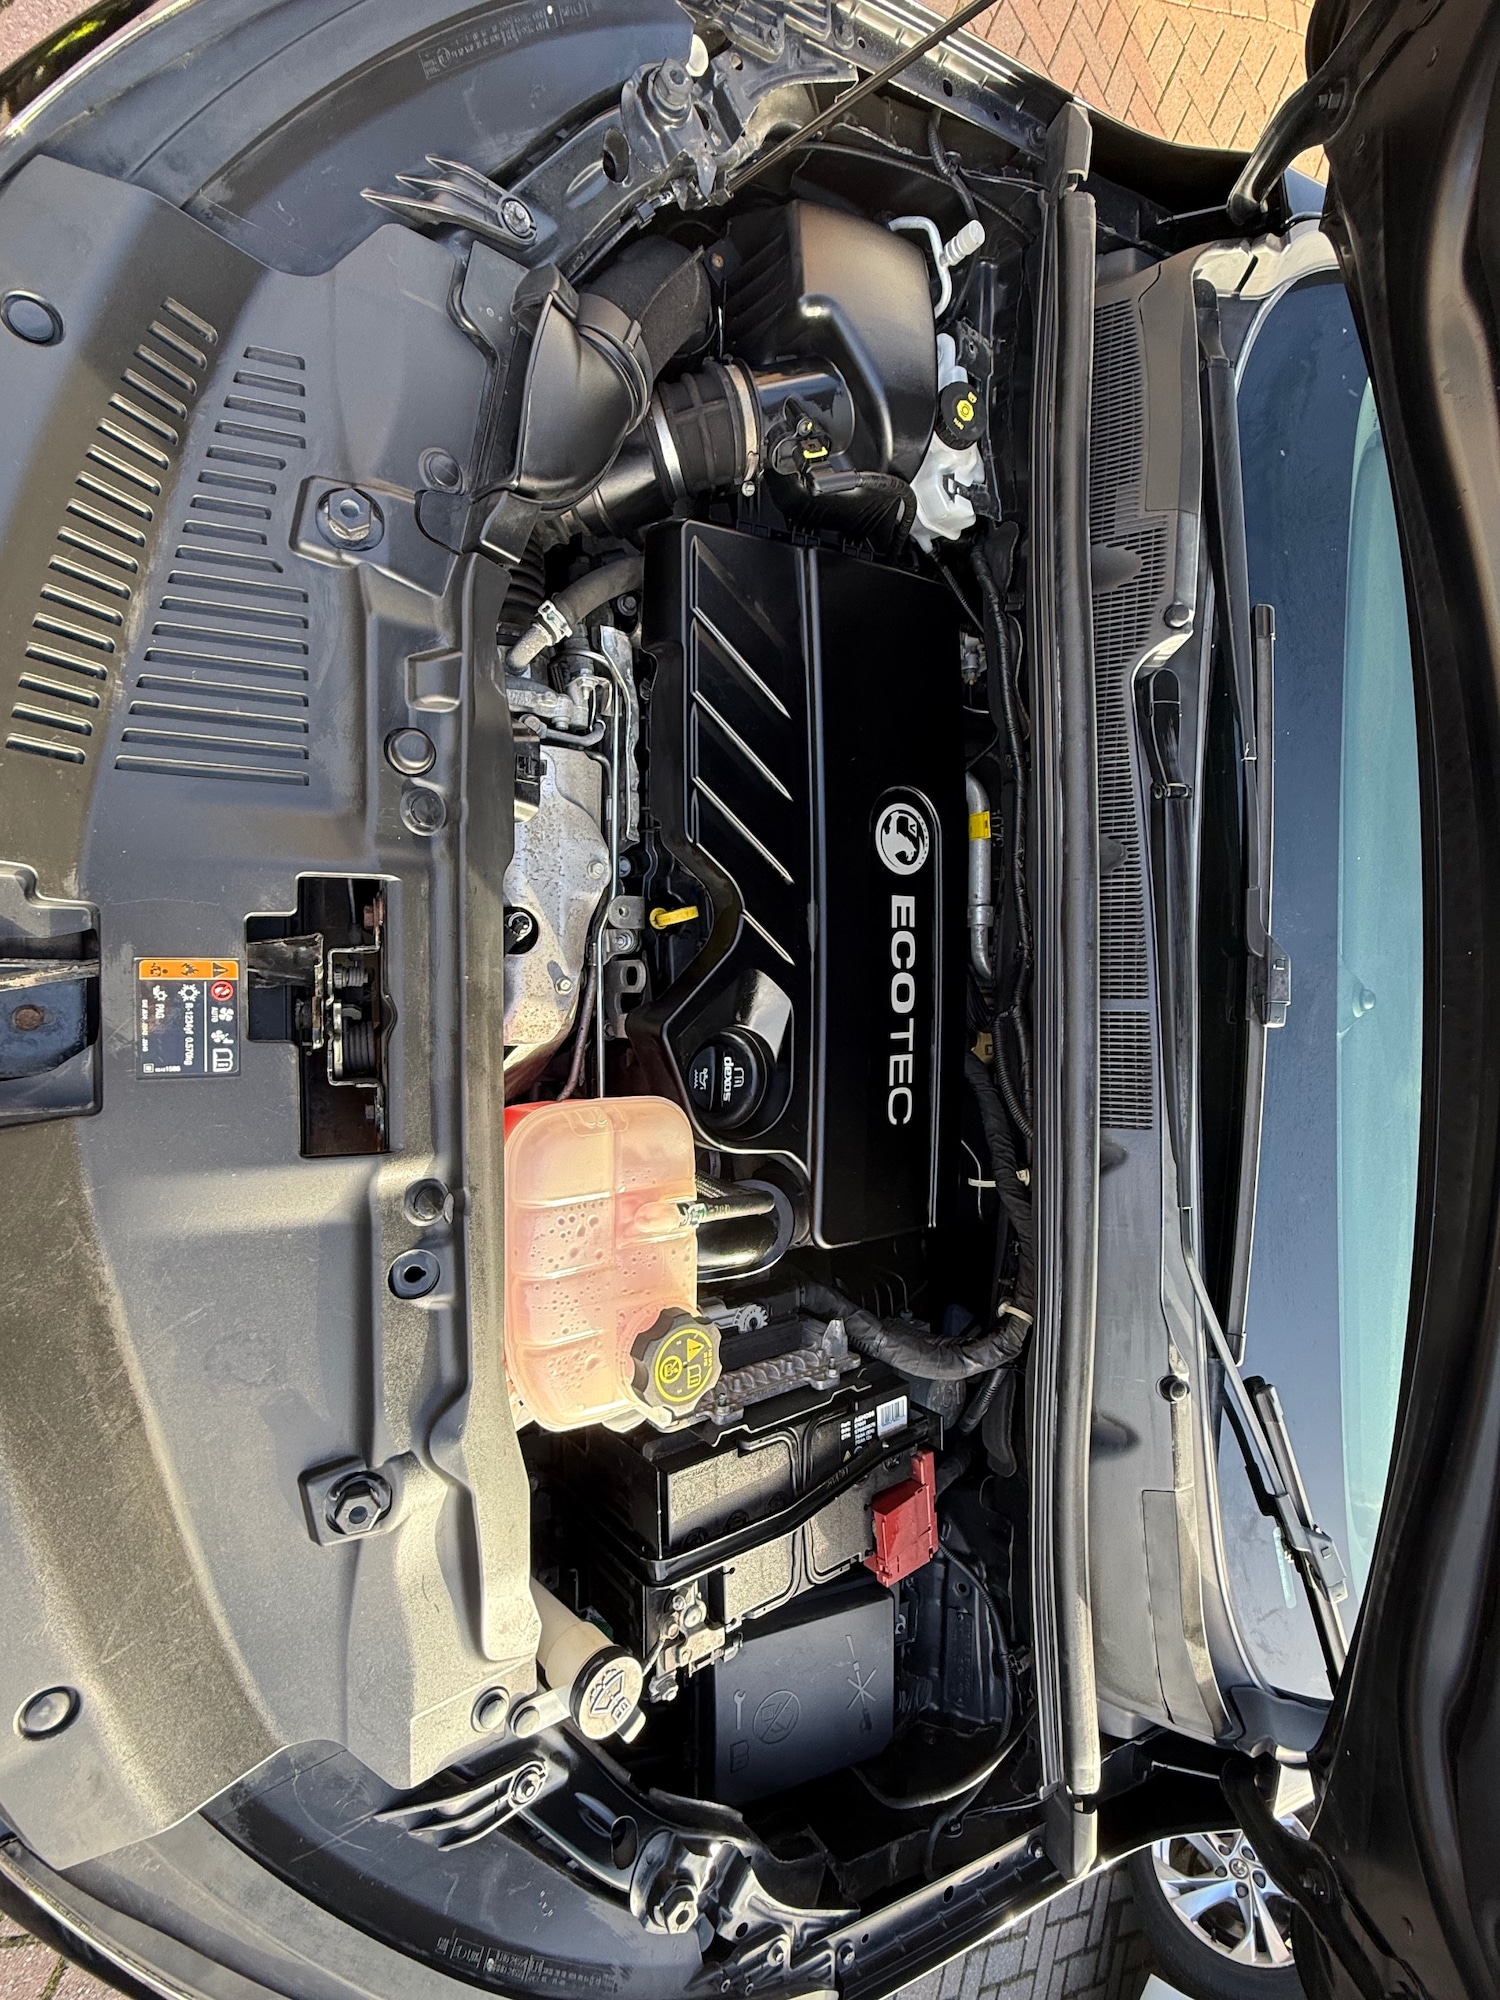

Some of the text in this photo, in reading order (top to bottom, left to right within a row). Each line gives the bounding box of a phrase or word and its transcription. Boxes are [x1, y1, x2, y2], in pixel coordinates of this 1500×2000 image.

[155, 1003, 165, 1019] PAG
[210, 1006, 218, 1023] AUTO
[888, 894, 916, 1125] ECOTEC
[183, 1002, 194, 1066] R-1234yf 0.570kg
[723, 1056, 735, 1102] dexos
